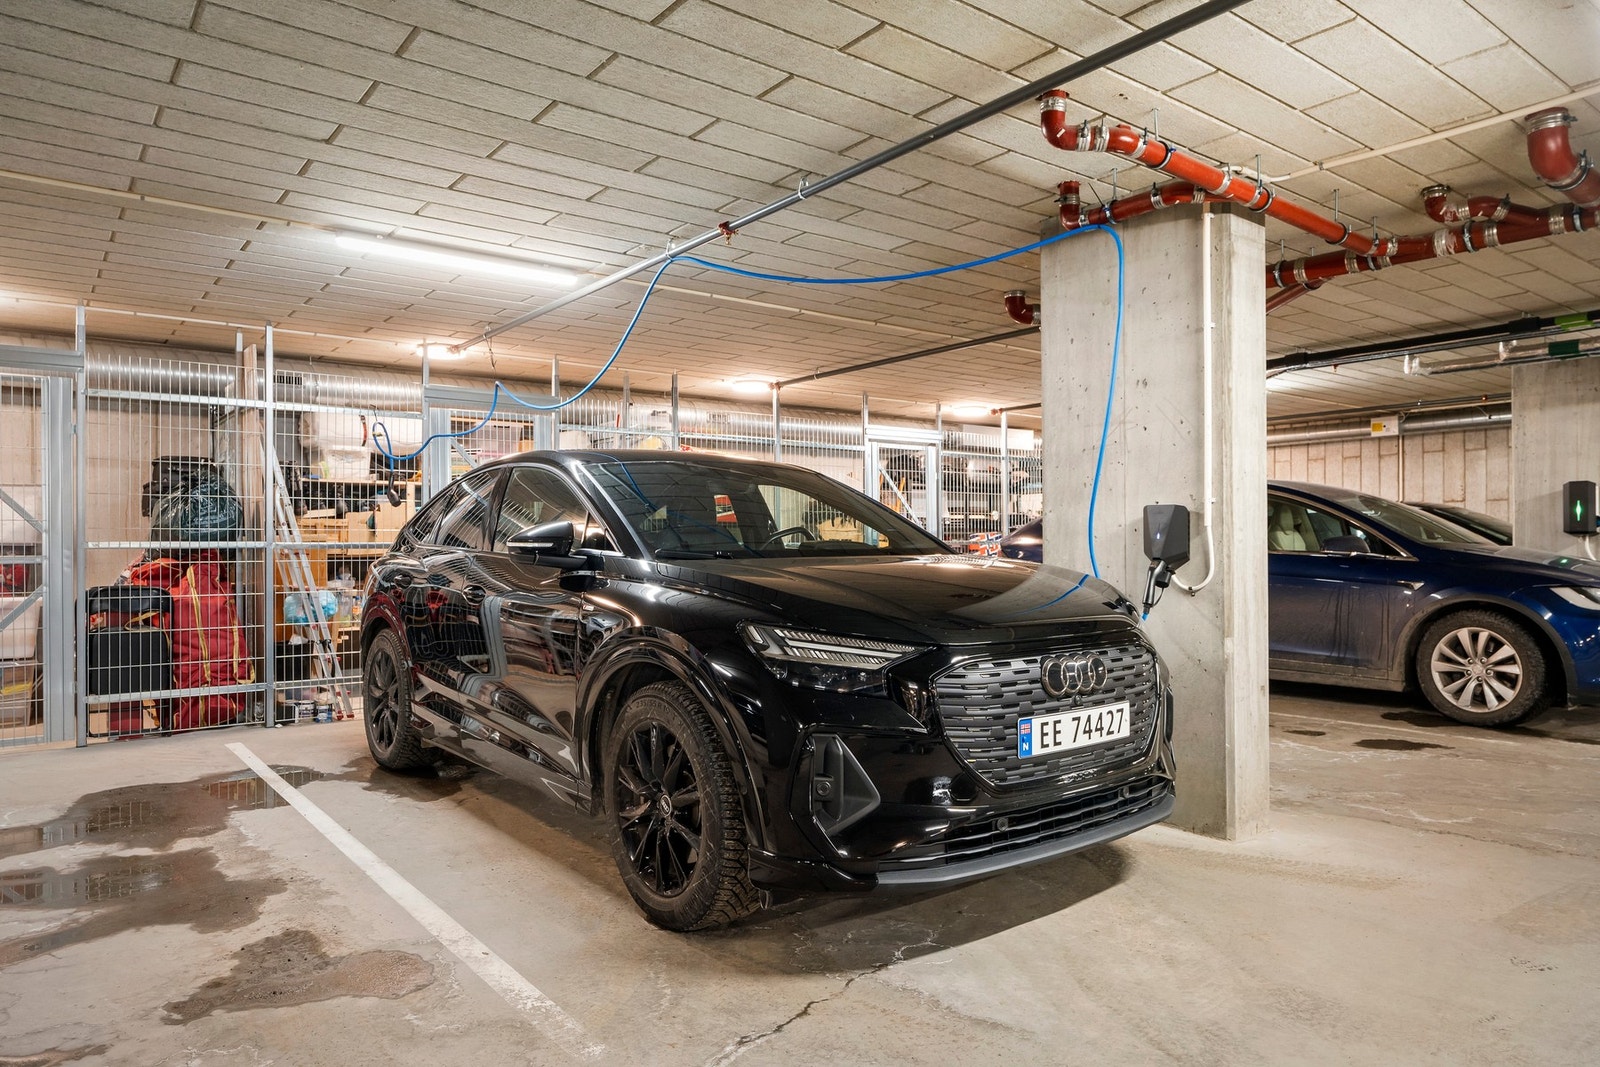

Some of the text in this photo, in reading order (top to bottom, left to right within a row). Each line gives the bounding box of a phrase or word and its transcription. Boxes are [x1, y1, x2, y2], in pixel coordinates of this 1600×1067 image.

[1040, 707, 1124, 749] EE 74427
[1022, 742, 1029, 751] N
